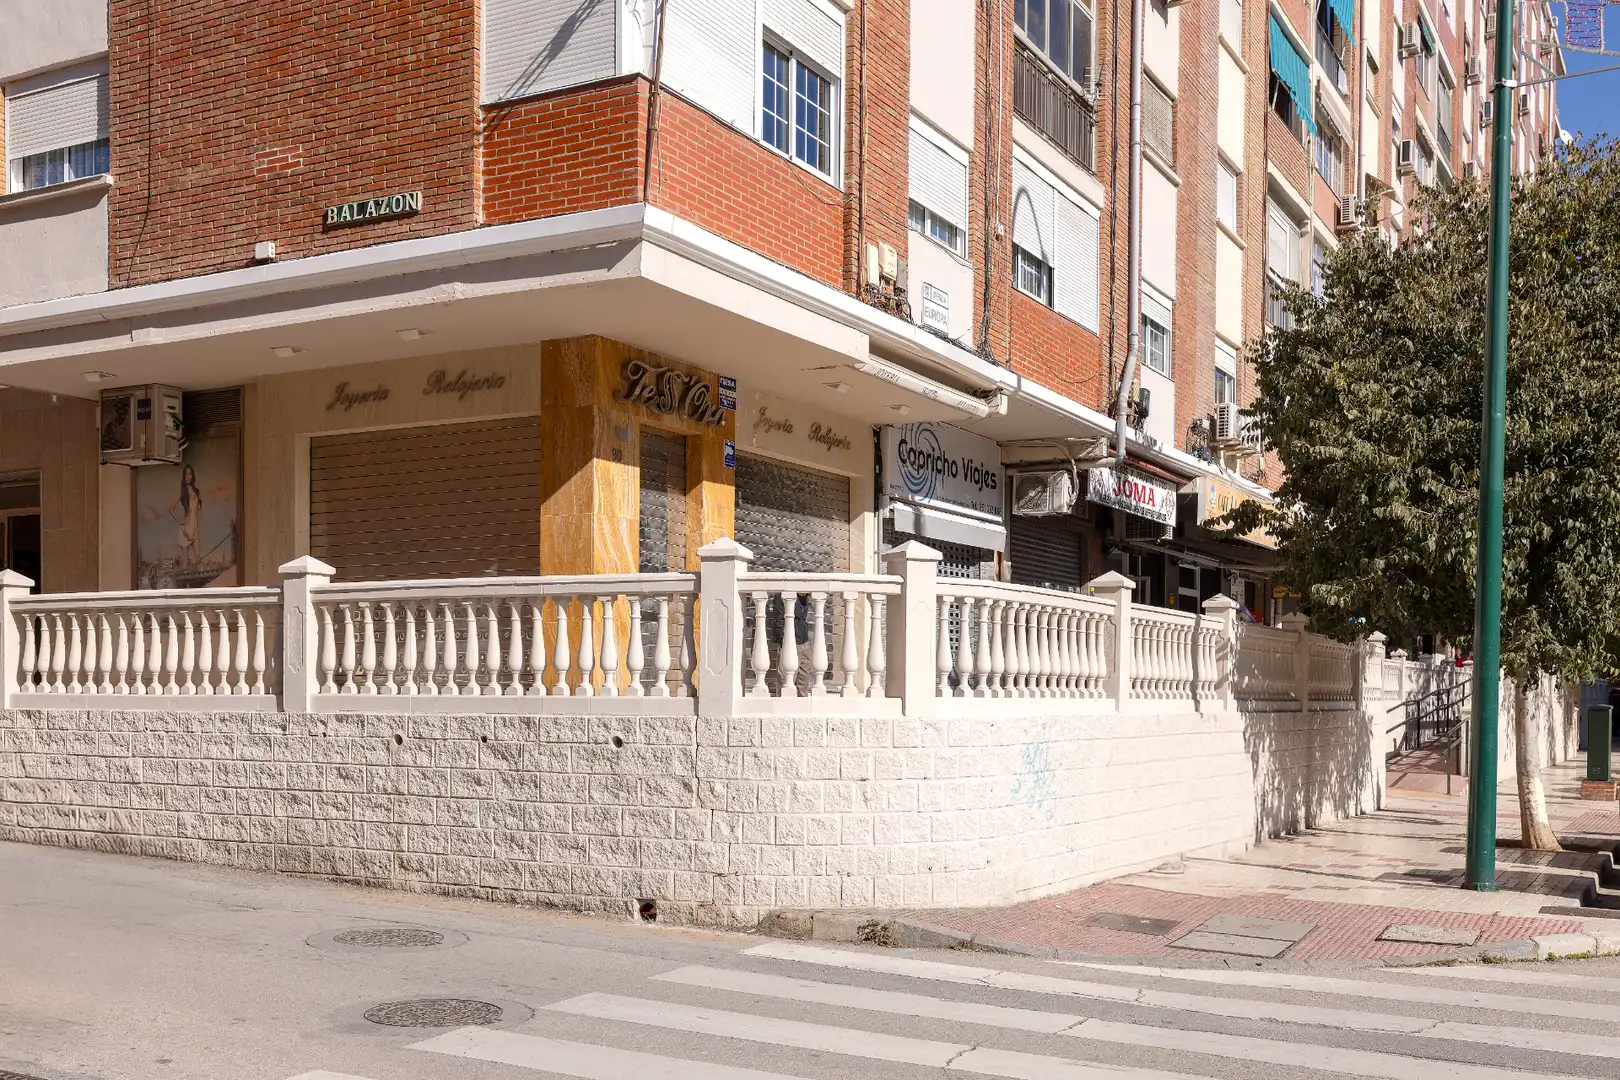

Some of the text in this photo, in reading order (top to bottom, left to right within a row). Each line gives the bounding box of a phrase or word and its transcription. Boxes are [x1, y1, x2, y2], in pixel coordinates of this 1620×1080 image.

[326, 192, 419, 225] BALAZON
[924, 306, 948, 326] EUROPA
[898, 438, 997, 491] Capricho Viajes
